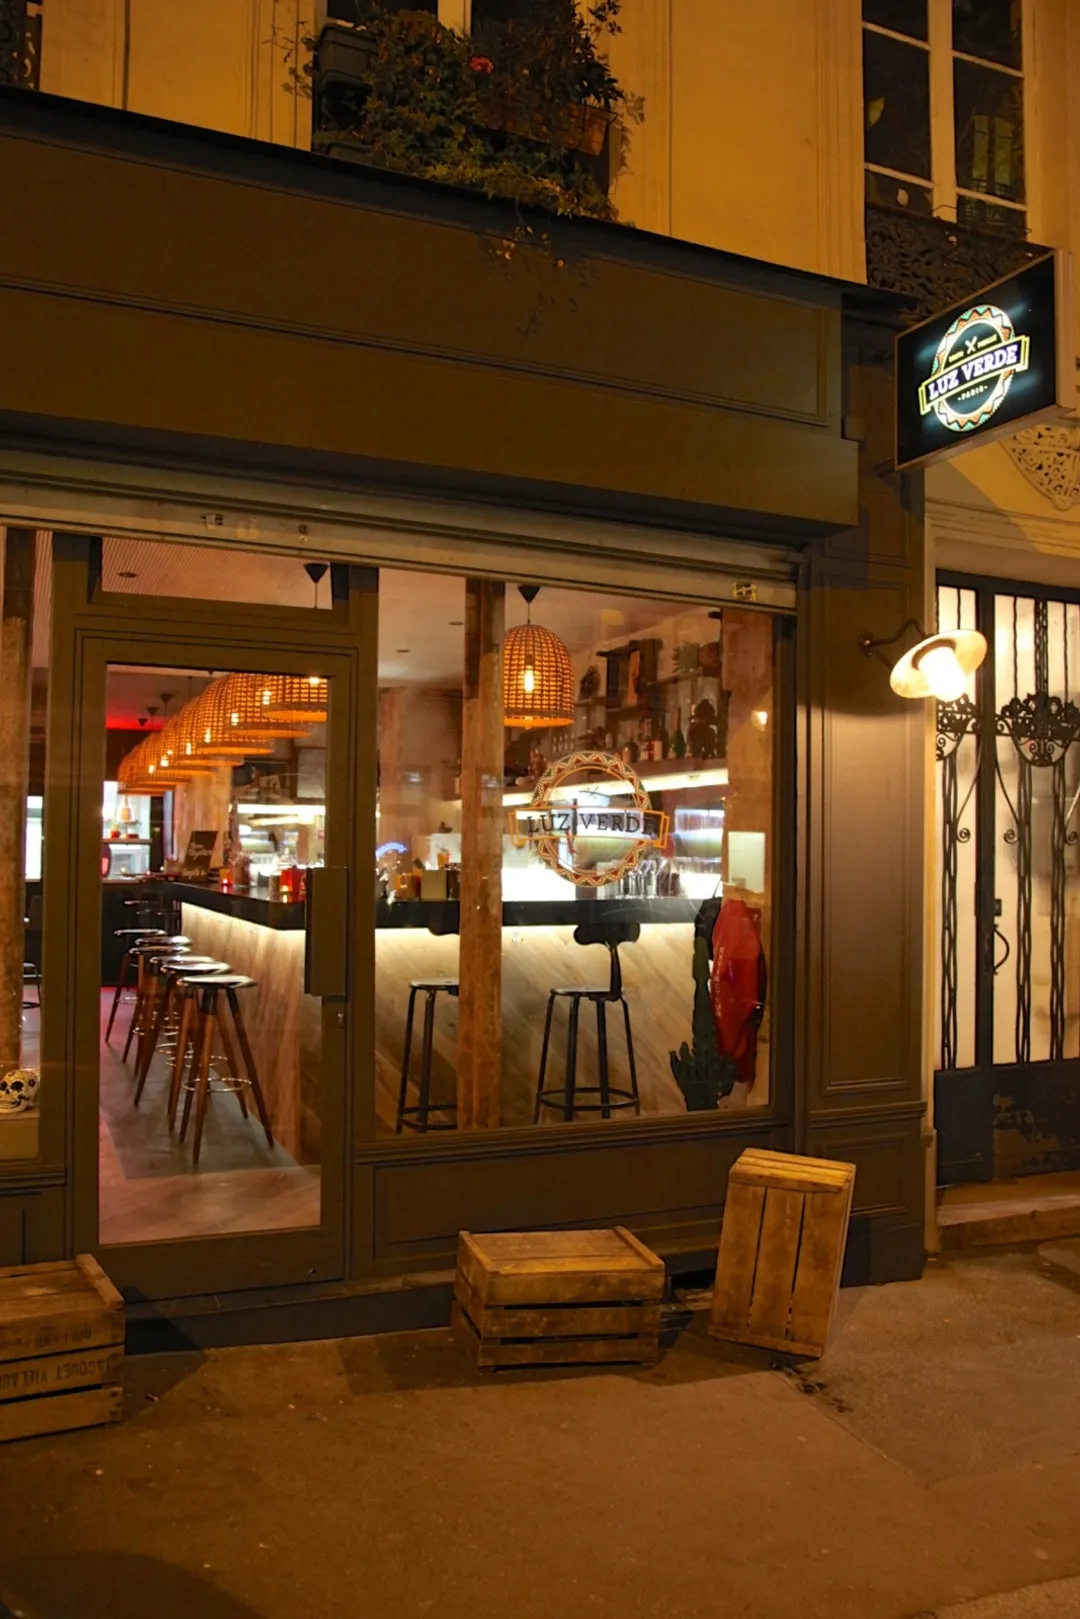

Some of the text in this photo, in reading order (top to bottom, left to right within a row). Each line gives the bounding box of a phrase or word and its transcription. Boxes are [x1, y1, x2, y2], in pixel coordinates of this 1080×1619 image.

[928, 344, 1019, 401] LUZ VERDE
[527, 812, 655, 836] LUZ VERDE
